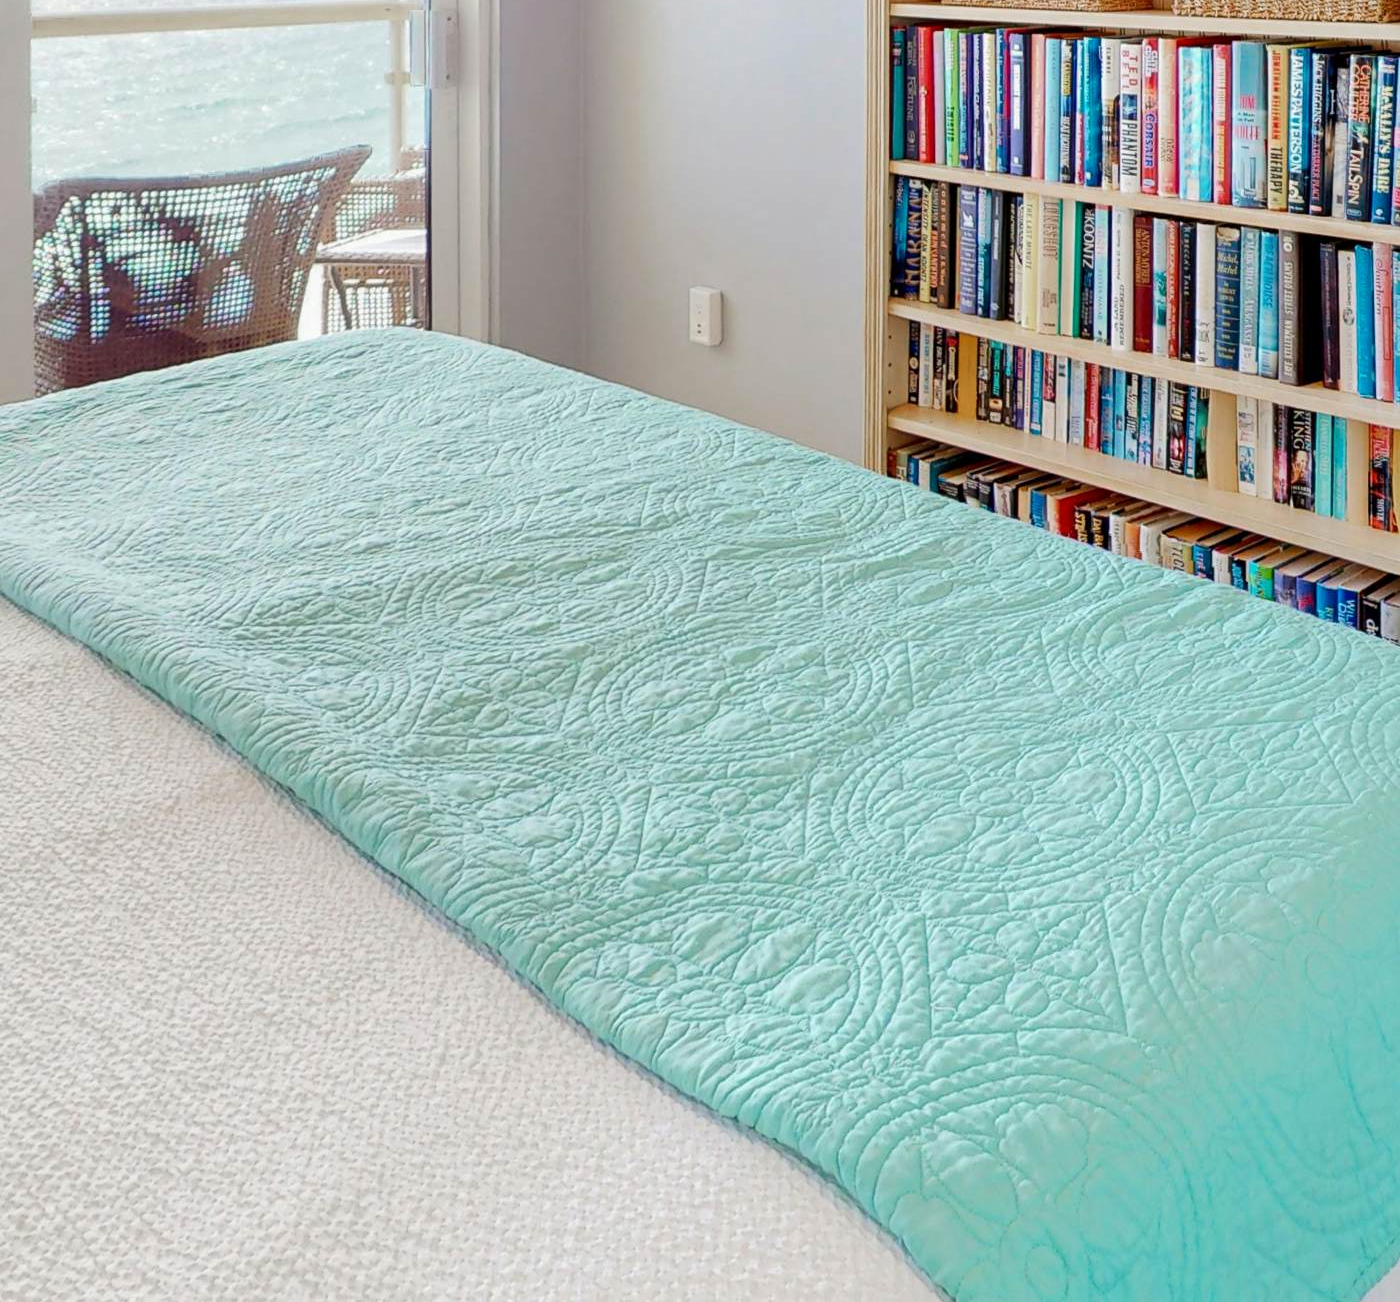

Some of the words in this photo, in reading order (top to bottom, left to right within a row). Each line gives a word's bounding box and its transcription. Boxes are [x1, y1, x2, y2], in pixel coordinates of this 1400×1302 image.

[1129, 56, 1138, 86] TED
[1272, 50, 1280, 92] JONATHAN
[1291, 55, 1303, 96] JAMES
[1314, 58, 1324, 81] JACK
[906, 76, 916, 121] FORTUNE
[1239, 94, 1255, 110] TOM
[1313, 83, 1322, 123] HIGGINS
[1350, 63, 1359, 122] COULTER
[1359, 64, 1372, 123] CATHERINE
[1272, 95, 1280, 140] KELLERMAN
[1291, 97, 1302, 173] PATTERSON
[1122, 122, 1138, 176] PHANTOM
[1144, 113, 1155, 168] CORSAIR
[1271, 147, 1282, 194] THERAPY
[1312, 179, 1320, 201] PLACE
[1348, 147, 1364, 204] TAILSPIN
[1377, 158, 1390, 193] DARE
[1083, 216, 1094, 269] KOONTZ
[1142, 229, 1150, 257] ANTON
[1183, 226, 1192, 271] REBECCA'S
[1217, 252, 1239, 264] Michel,
[1246, 241, 1254, 264] MARK
[1217, 264, 1238, 275] Michel
[1246, 266, 1254, 290] MILLS
[1284, 262, 1293, 288] DREAMS
[1376, 258, 1388, 315] Southern
[1263, 277, 1273, 308] HOUSE
[1284, 290, 1293, 314] STREET
[1284, 320, 1294, 359] KELLERMAN
[1284, 361, 1293, 376] FAYE
[1293, 410, 1304, 450] KING
